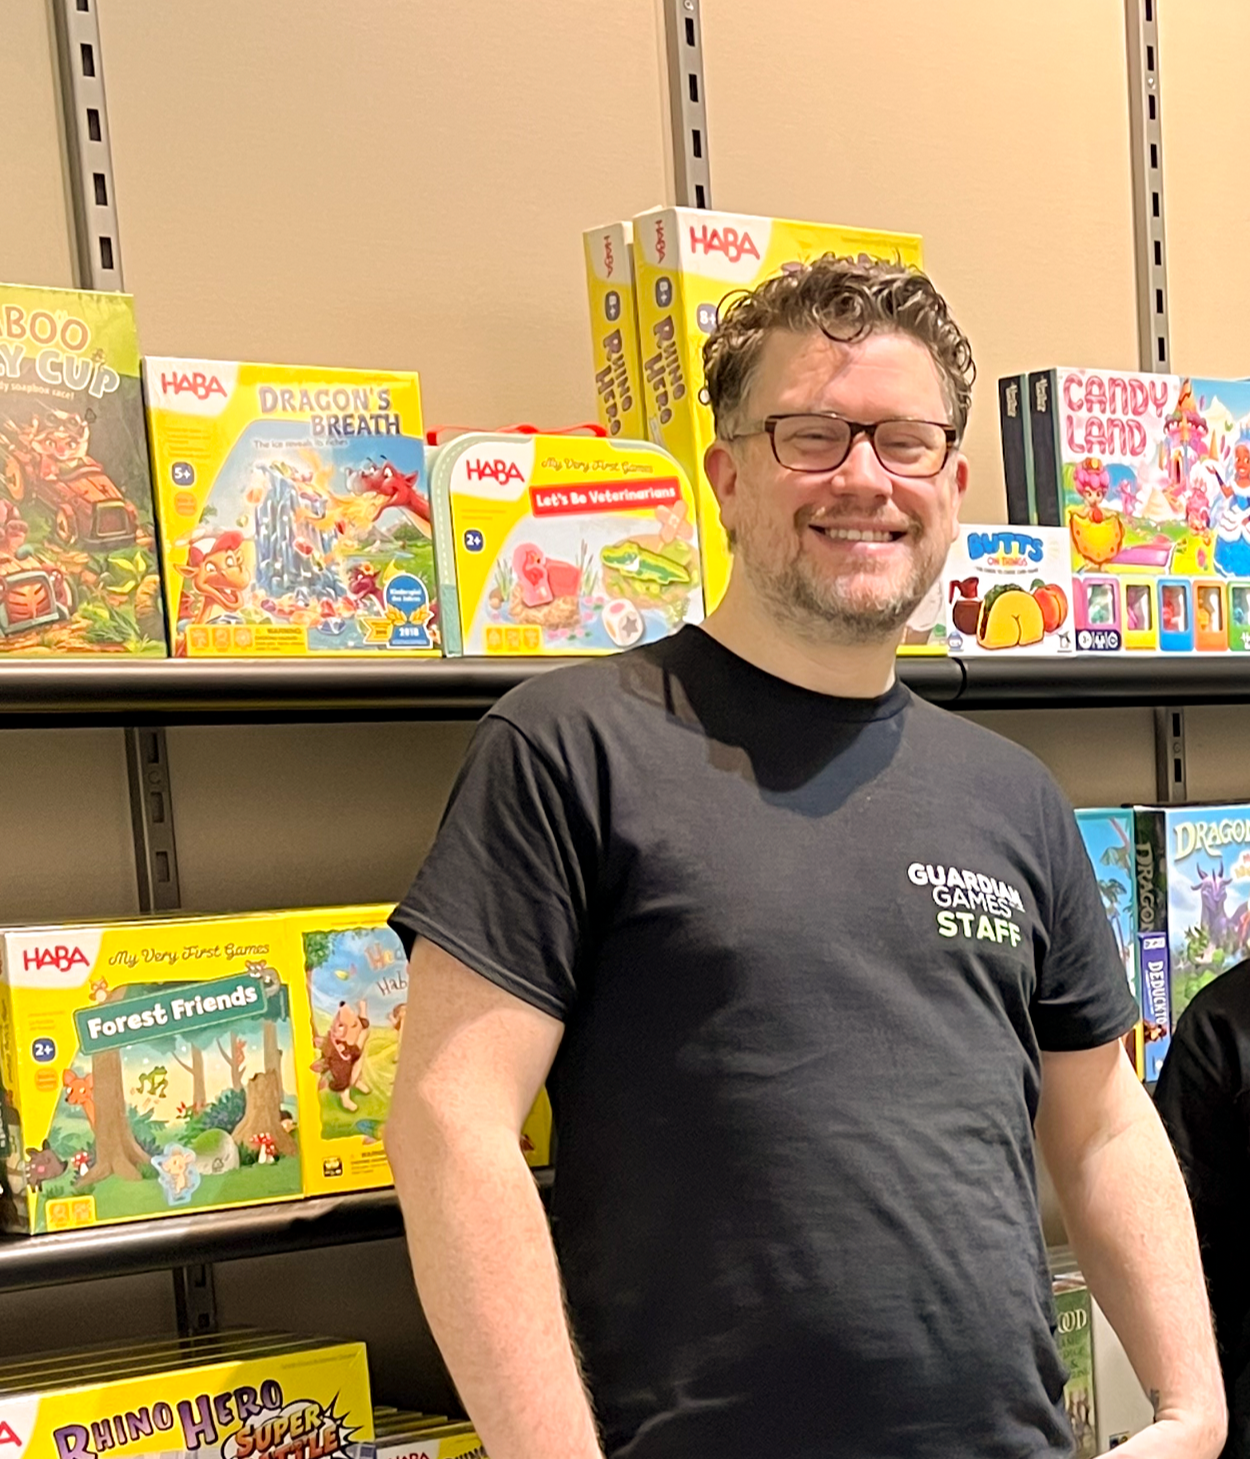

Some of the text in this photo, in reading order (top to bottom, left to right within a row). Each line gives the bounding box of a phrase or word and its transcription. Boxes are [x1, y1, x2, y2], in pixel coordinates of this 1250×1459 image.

[689, 224, 760, 263] HABA
[0, 303, 90, 351] BOO
[36, 348, 121, 399] CUP
[602, 328, 633, 413] RHINO
[652, 315, 687, 402] RHINO
[161, 371, 228, 400] HABA
[258, 385, 392, 414] DRAGON'S
[595, 366, 622, 436] HERO
[644, 353, 673, 426] HERO
[1062, 373, 1169, 418] CANDY
[311, 412, 401, 437] BREATH
[1066, 414, 1147, 457] LAND
[173, 466, 192, 480] 5+
[466, 458, 525, 486] HABA
[536, 485, 676, 508] Let's Be Veterinarians
[465, 533, 481, 547] 2+
[967, 531, 1044, 562] BUTTS
[907, 862, 1023, 909] GUARDIAN
[932, 885, 1012, 918] GAMES
[937, 910, 1021, 947] STAFF
[23, 945, 90, 972] HABA
[108, 942, 270, 968] My Very First Games
[87, 985, 258, 1040] Forest Friends
[34, 1043, 54, 1058] 2+
[175, 1379, 285, 1452] HERO
[233, 1403, 326, 1459] SUPER
